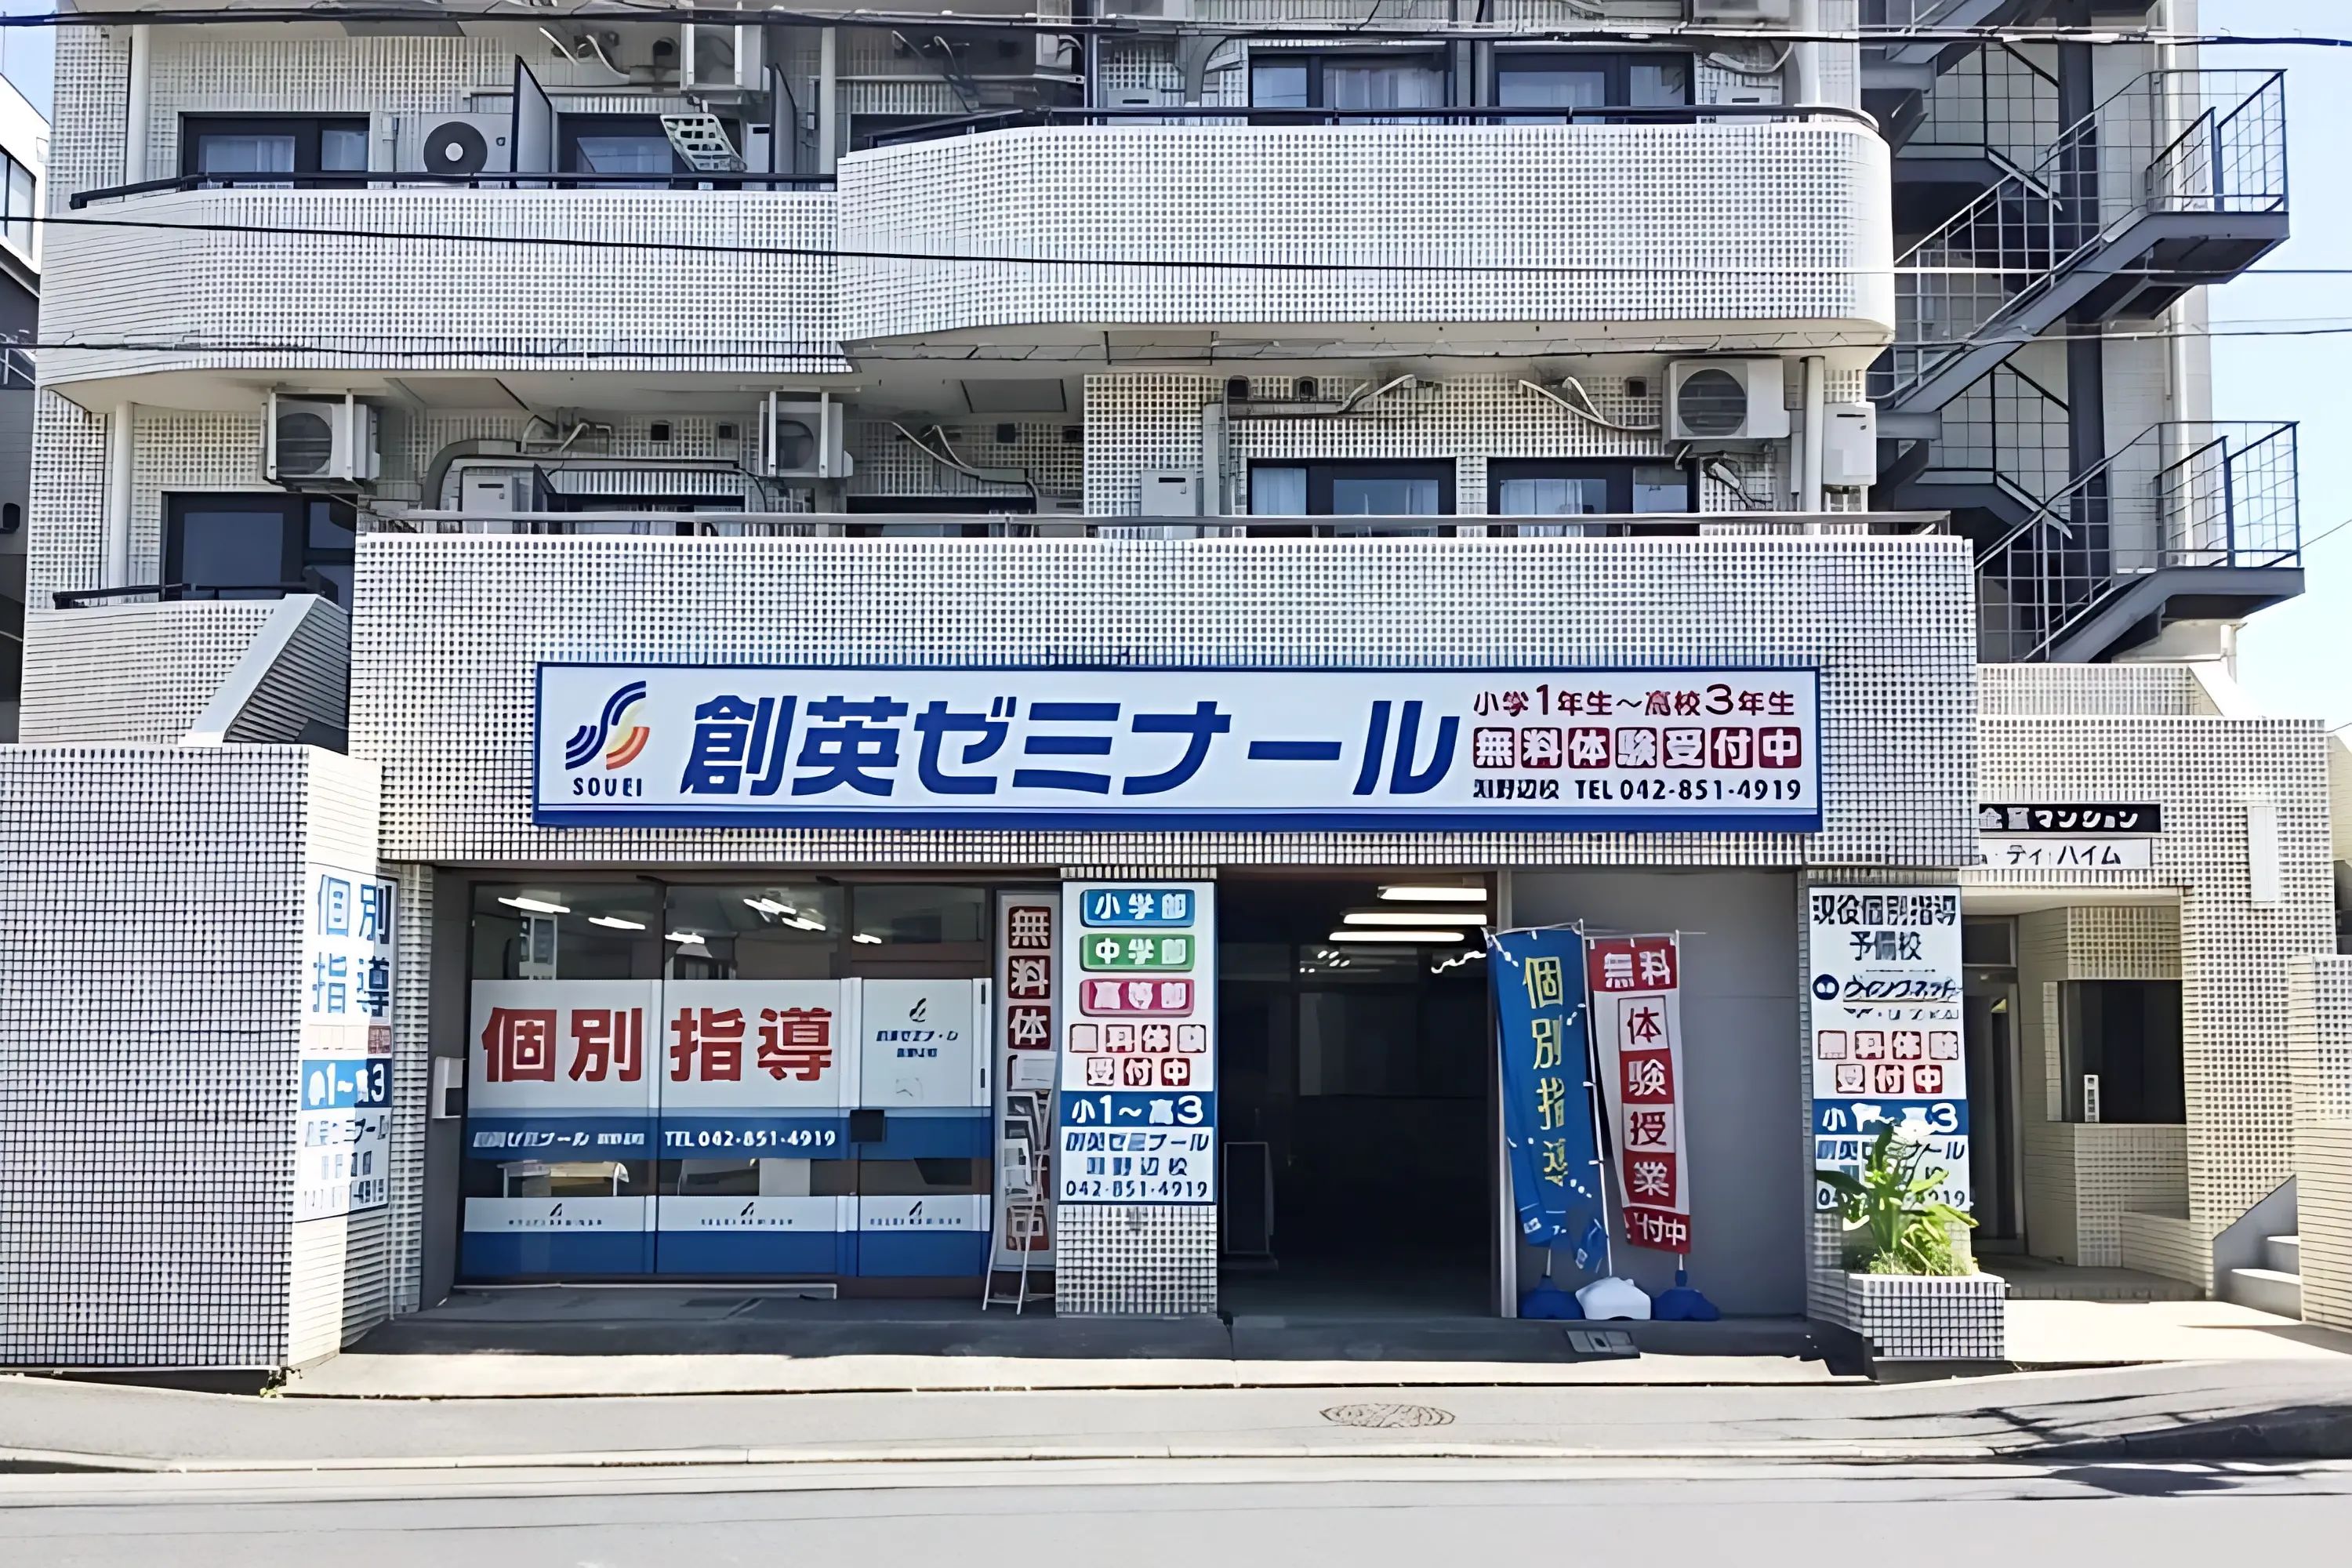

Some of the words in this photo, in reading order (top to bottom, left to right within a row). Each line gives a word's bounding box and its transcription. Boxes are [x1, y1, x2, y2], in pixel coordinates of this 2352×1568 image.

[680, 695, 1460, 797] 創英ゼミナール
[1476, 728, 1798, 768] 無料体験受付中
[573, 777, 642, 797] SOUEI
[1575, 779, 1613, 800] TEL
[481, 1007, 833, 1083] 個別指導
[1523, 955, 1569, 1187] 個別指導
[1625, 1005, 1670, 1197] 体験授業
[1624, 1212, 1686, 1247] 付中
